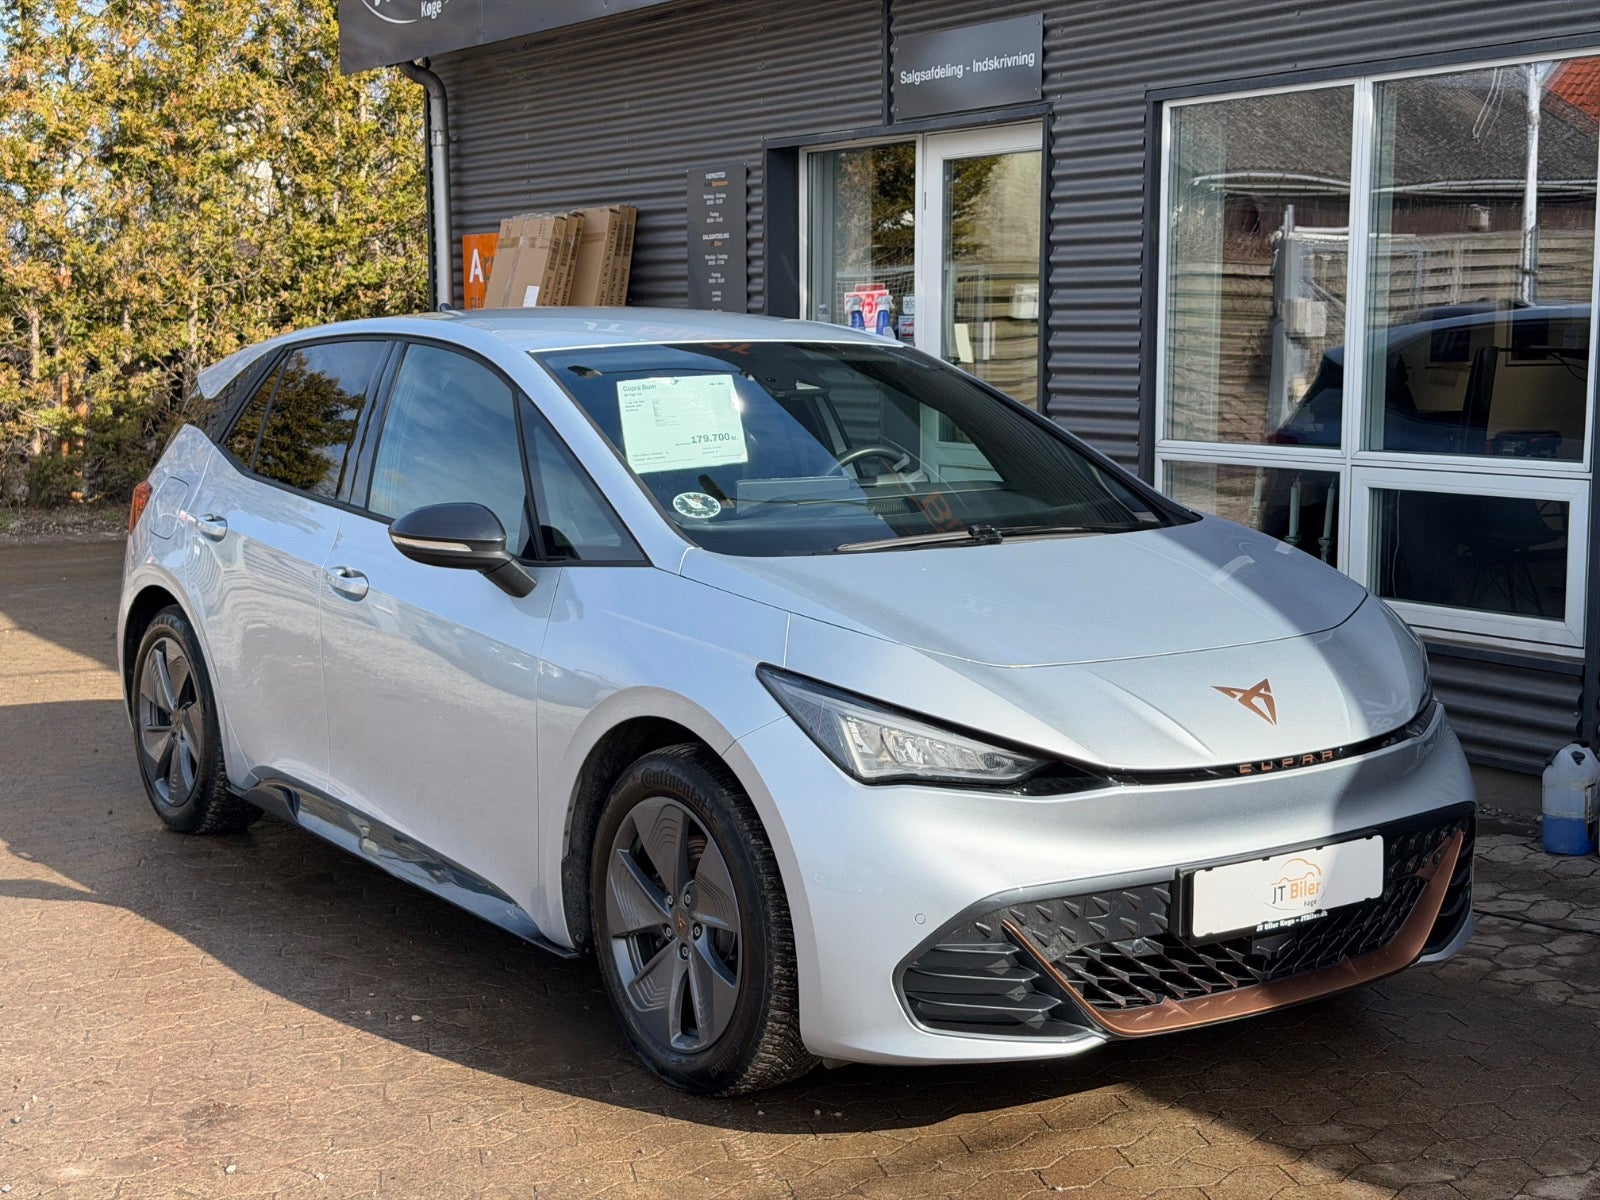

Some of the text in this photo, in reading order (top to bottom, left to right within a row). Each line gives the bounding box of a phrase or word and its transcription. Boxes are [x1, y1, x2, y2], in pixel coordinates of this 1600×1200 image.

[420, 0, 442, 19] Køge
[900, 63, 964, 85] Salgsafdeling
[972, 51, 1036, 73] Indskrivning
[691, 432, 731, 444] 179.700
[1239, 749, 1333, 775] CUPRA
[641, 768, 708, 813] Continental
[1271, 880, 1321, 905] JT Biler
